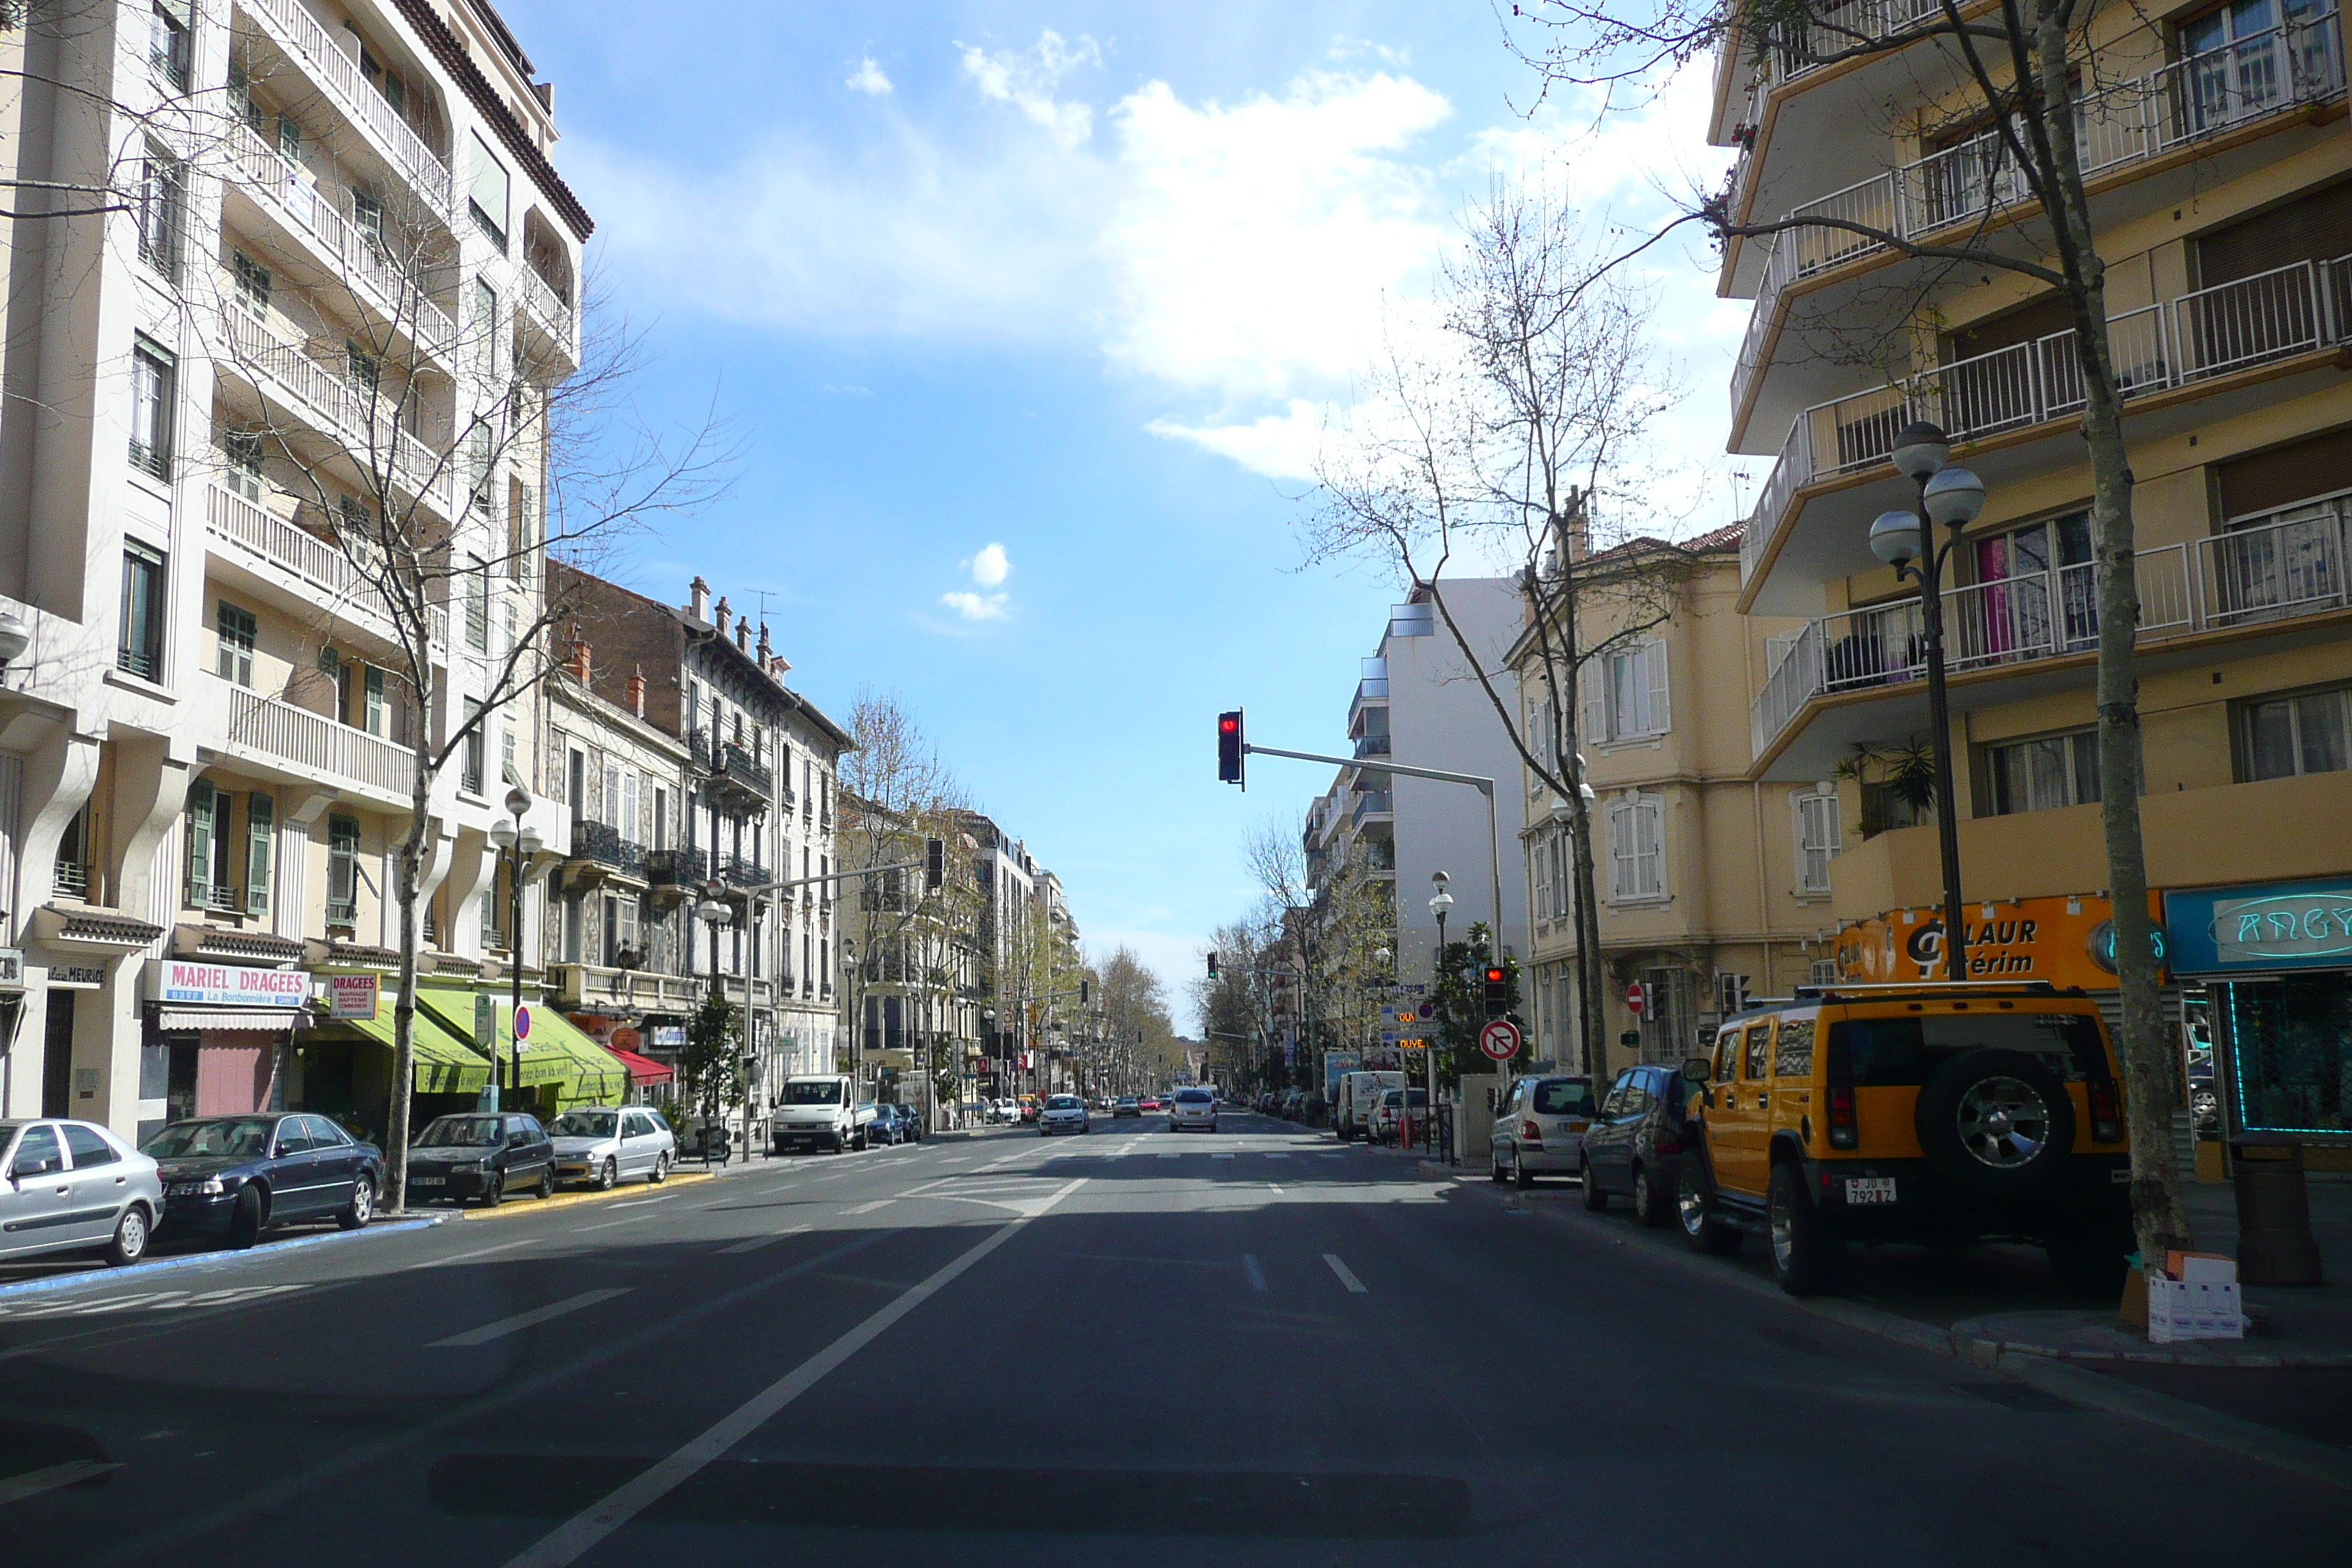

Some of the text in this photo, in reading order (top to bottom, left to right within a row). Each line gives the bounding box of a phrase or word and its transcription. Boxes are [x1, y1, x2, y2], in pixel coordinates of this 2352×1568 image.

[0, 957, 18, 979] R
[1943, 950, 2032, 976] érim
[69, 967, 105, 983] MEURICE
[172, 965, 303, 993] MARIEL DRAGEES
[333, 977, 374, 990] DRAGEES
[208, 991, 271, 1003] La Bonbonnière
[535, 1066, 546, 1079] bon
[549, 1065, 555, 1077] la
[557, 1063, 568, 1076] vie!
[483, 1088, 490, 1097] P
[1865, 1178, 1877, 1188] JU
[1851, 1190, 1874, 1203] 792
